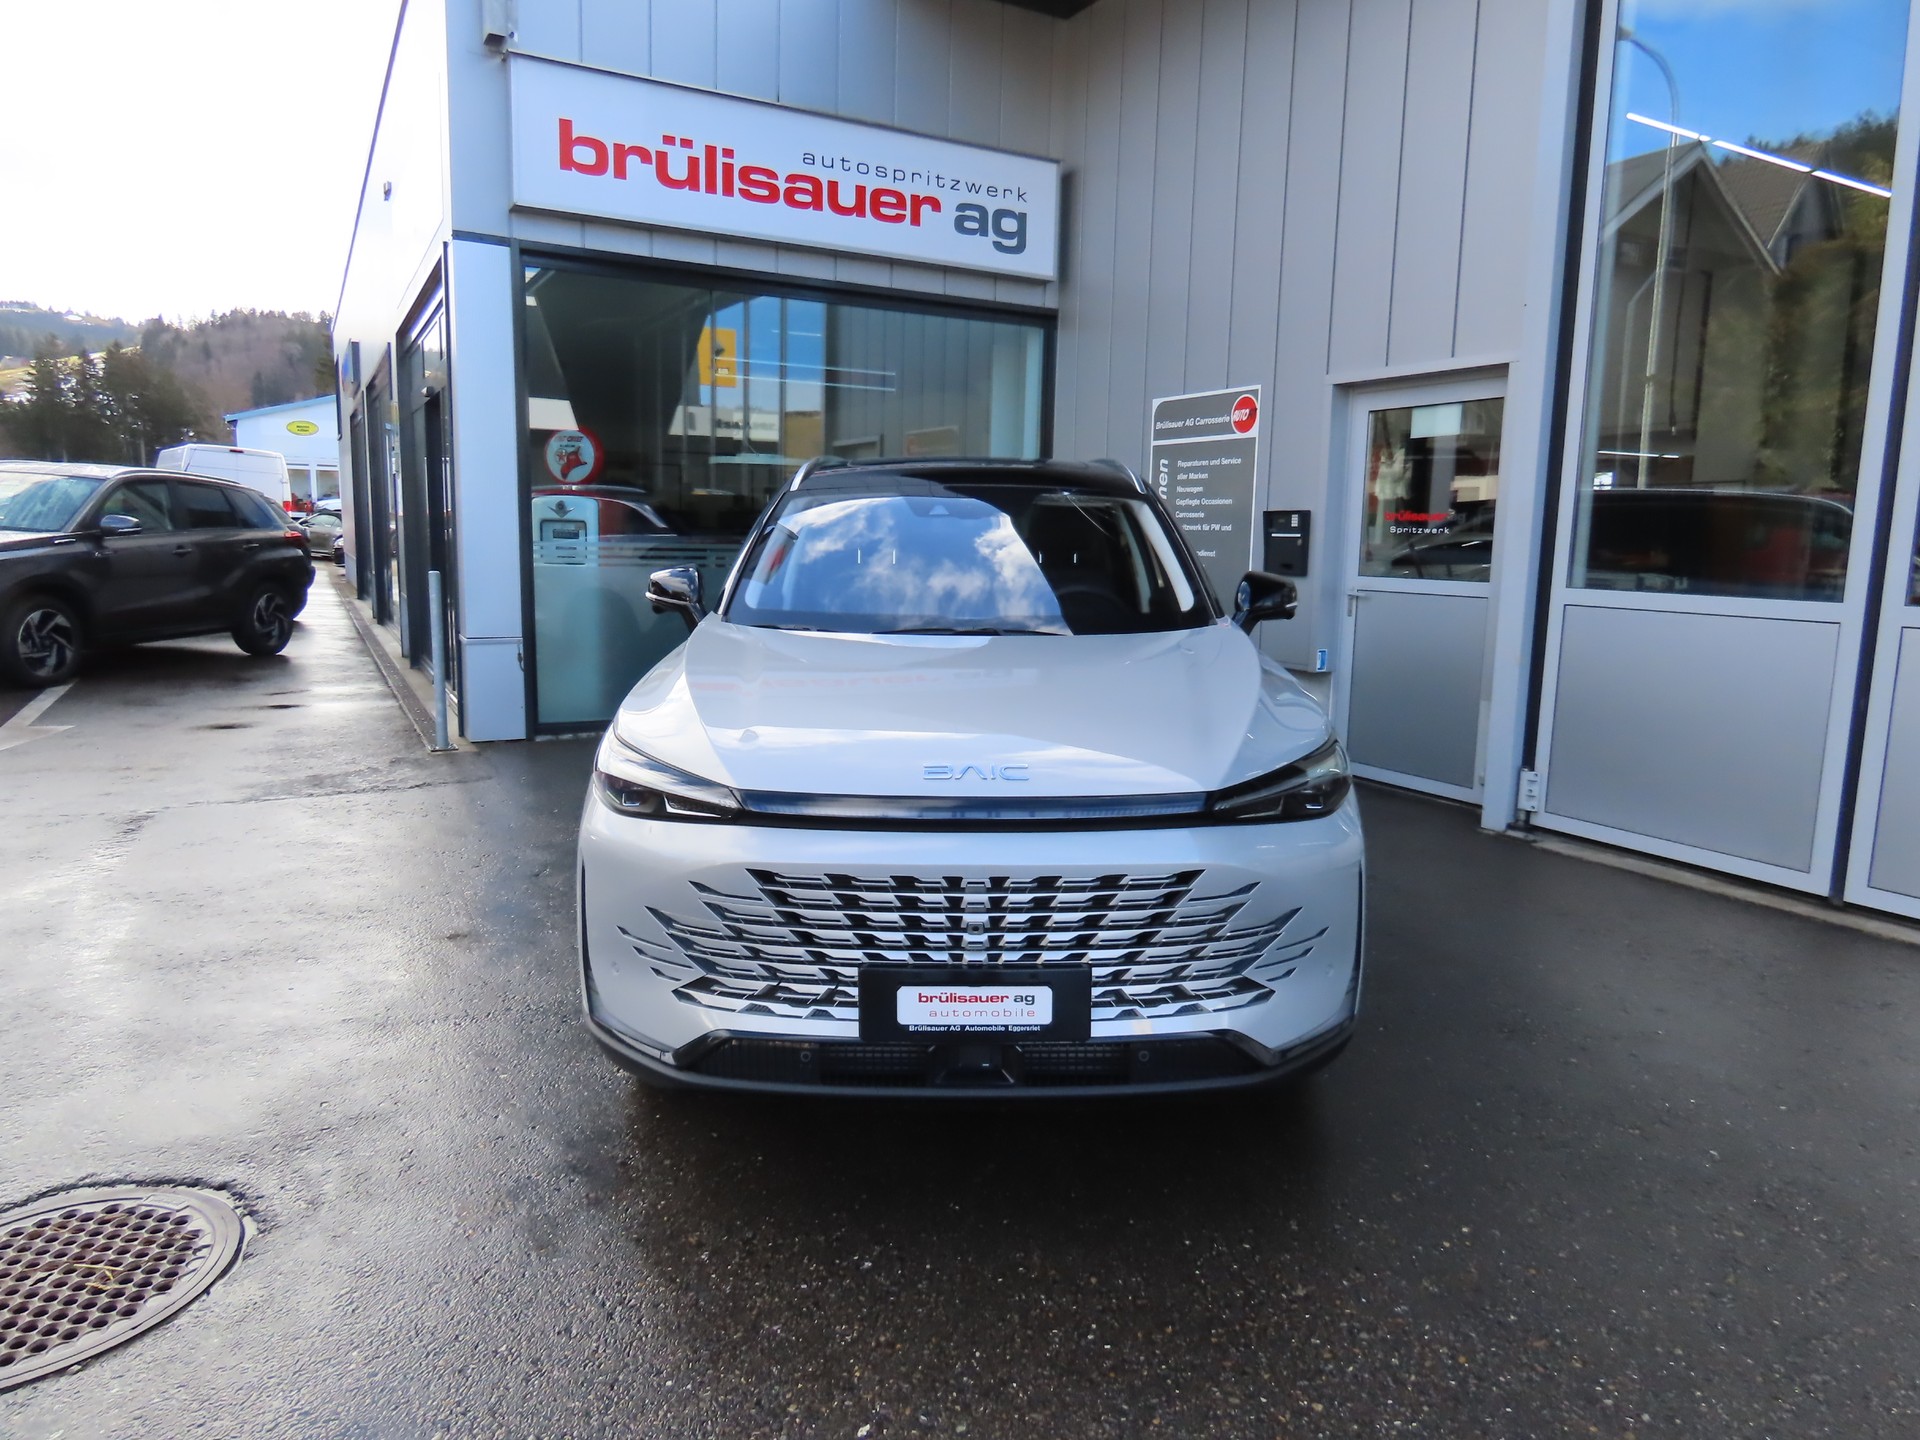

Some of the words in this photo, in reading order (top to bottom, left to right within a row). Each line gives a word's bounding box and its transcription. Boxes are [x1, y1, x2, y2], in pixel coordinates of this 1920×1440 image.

[802, 152, 1029, 204] autospritzwerk
[558, 117, 942, 227] brülisauer
[953, 201, 1028, 255] ag
[1184, 418, 1194, 427] AG
[1195, 415, 1230, 426] Carrosserie
[1177, 459, 1209, 469] Reparaturen
[1209, 458, 1220, 466] und
[1221, 457, 1242, 465] Service
[1188, 472, 1209, 480] Marken
[1176, 485, 1203, 494] Neuwagen
[1175, 498, 1200, 507] Gepflegte
[1175, 511, 1205, 519] Carrosserie
[1202, 523, 1210, 531] für
[1210, 523, 1220, 531] PW
[1389, 525, 1450, 534] Spritzwerk
[923, 763, 1030, 781] BAIC
[918, 991, 1009, 1003] brülisauer
[1014, 993, 1036, 1005] ag
[929, 1008, 1036, 1017] automobile
[909, 1024, 948, 1032] Brülisauer
[964, 1024, 1006, 1032] Automobile
